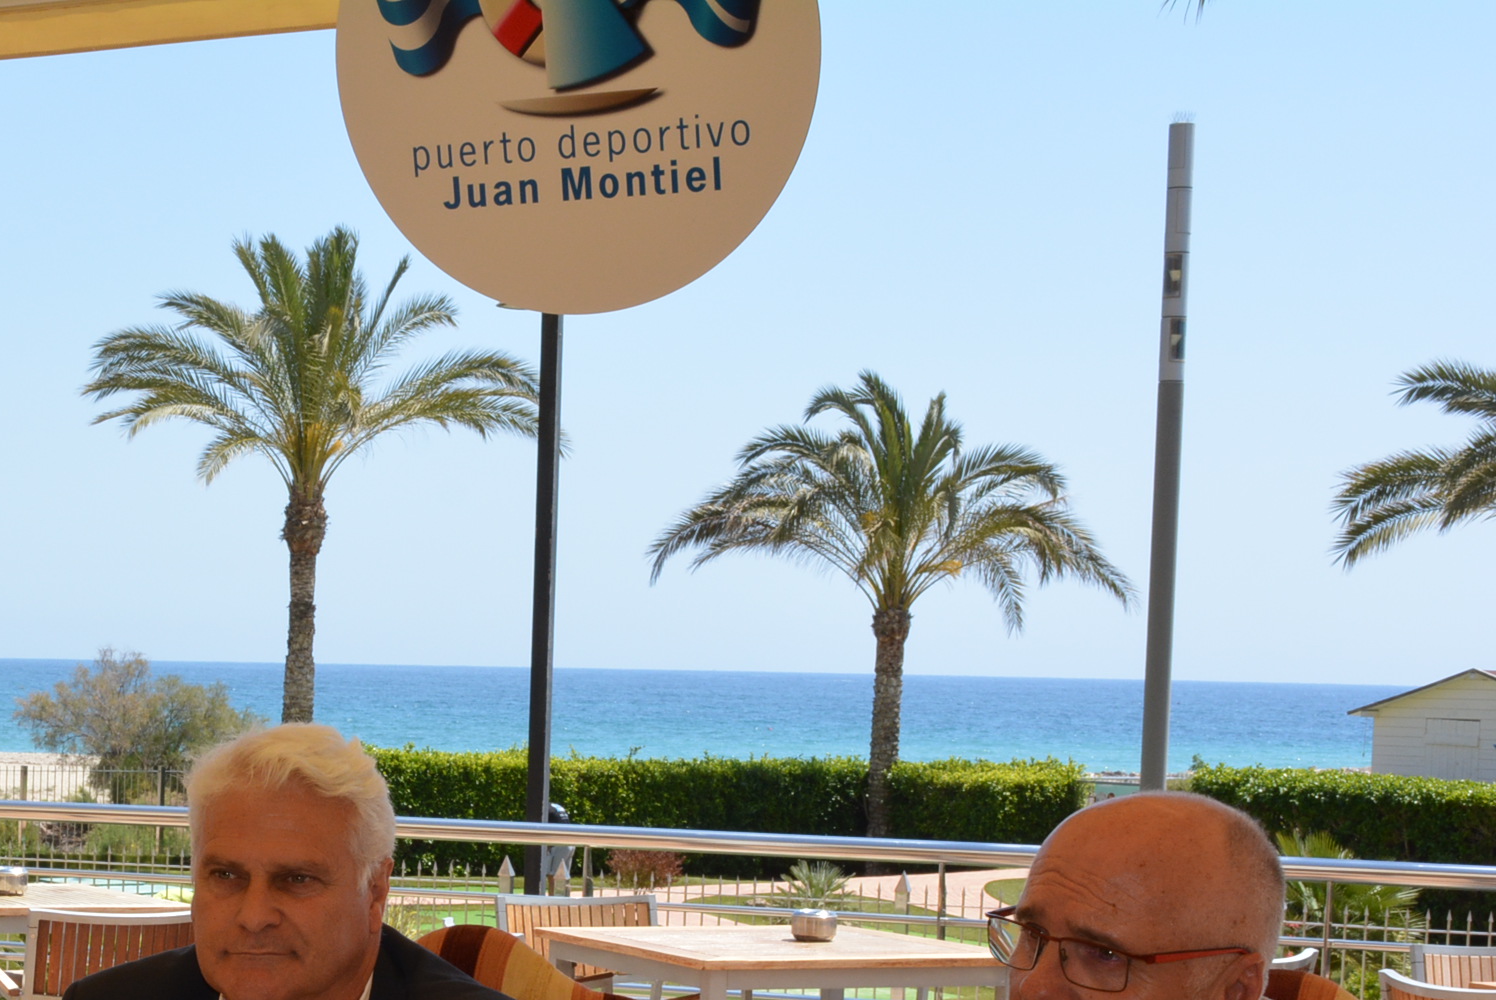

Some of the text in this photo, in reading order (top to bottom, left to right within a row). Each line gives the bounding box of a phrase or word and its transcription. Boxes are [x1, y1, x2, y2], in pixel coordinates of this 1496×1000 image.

[413, 114, 751, 178] puerto deportivo
[443, 157, 723, 210] Juan Montiel
